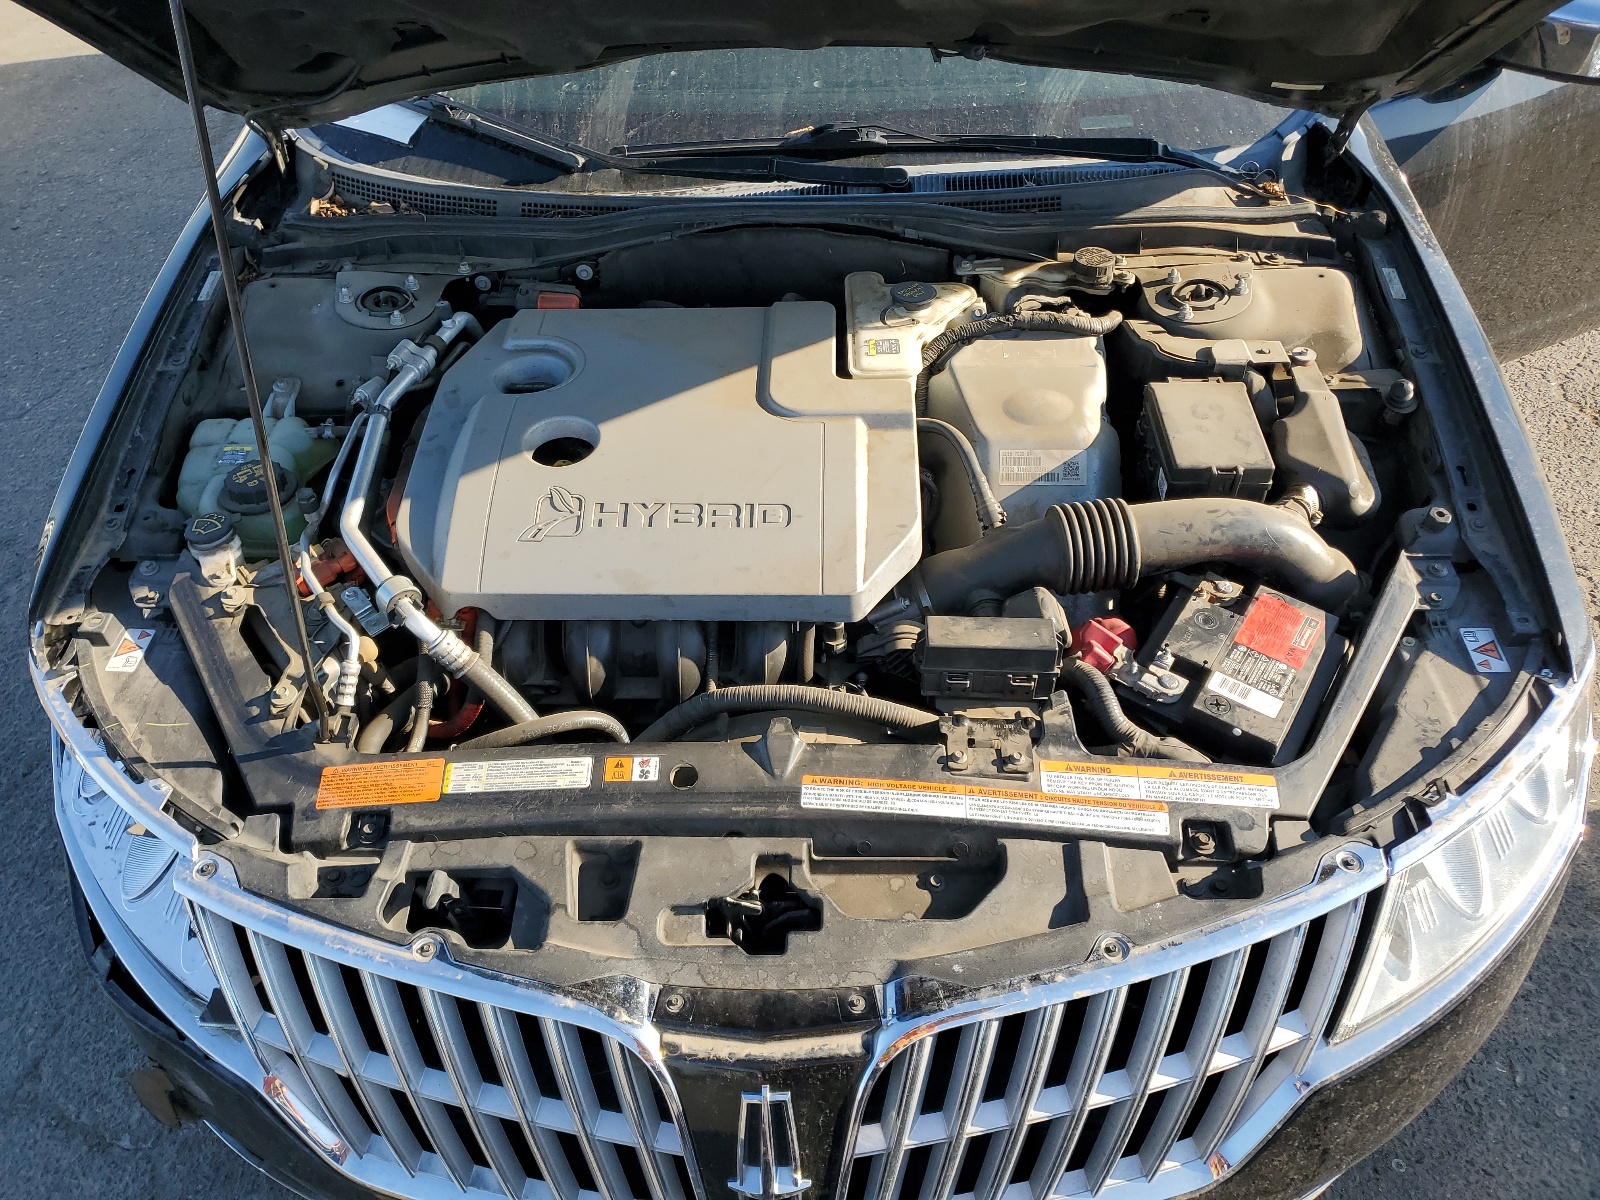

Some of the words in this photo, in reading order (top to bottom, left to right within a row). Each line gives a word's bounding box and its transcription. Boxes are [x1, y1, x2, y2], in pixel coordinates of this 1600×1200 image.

[591, 502, 792, 528] HYBRID
[1073, 764, 1112, 774] WARNING
[1179, 771, 1244, 782] AVERTISSEMENT
[819, 778, 863, 787] WARNING:
[886, 782, 917, 790] VOLTAGE
[978, 788, 1038, 800] AVERTISSEMENT
[1044, 795, 1072, 803] CIRCUITS
[1072, 797, 1091, 805] HAUTE
[1093, 799, 1117, 807] TENSION
